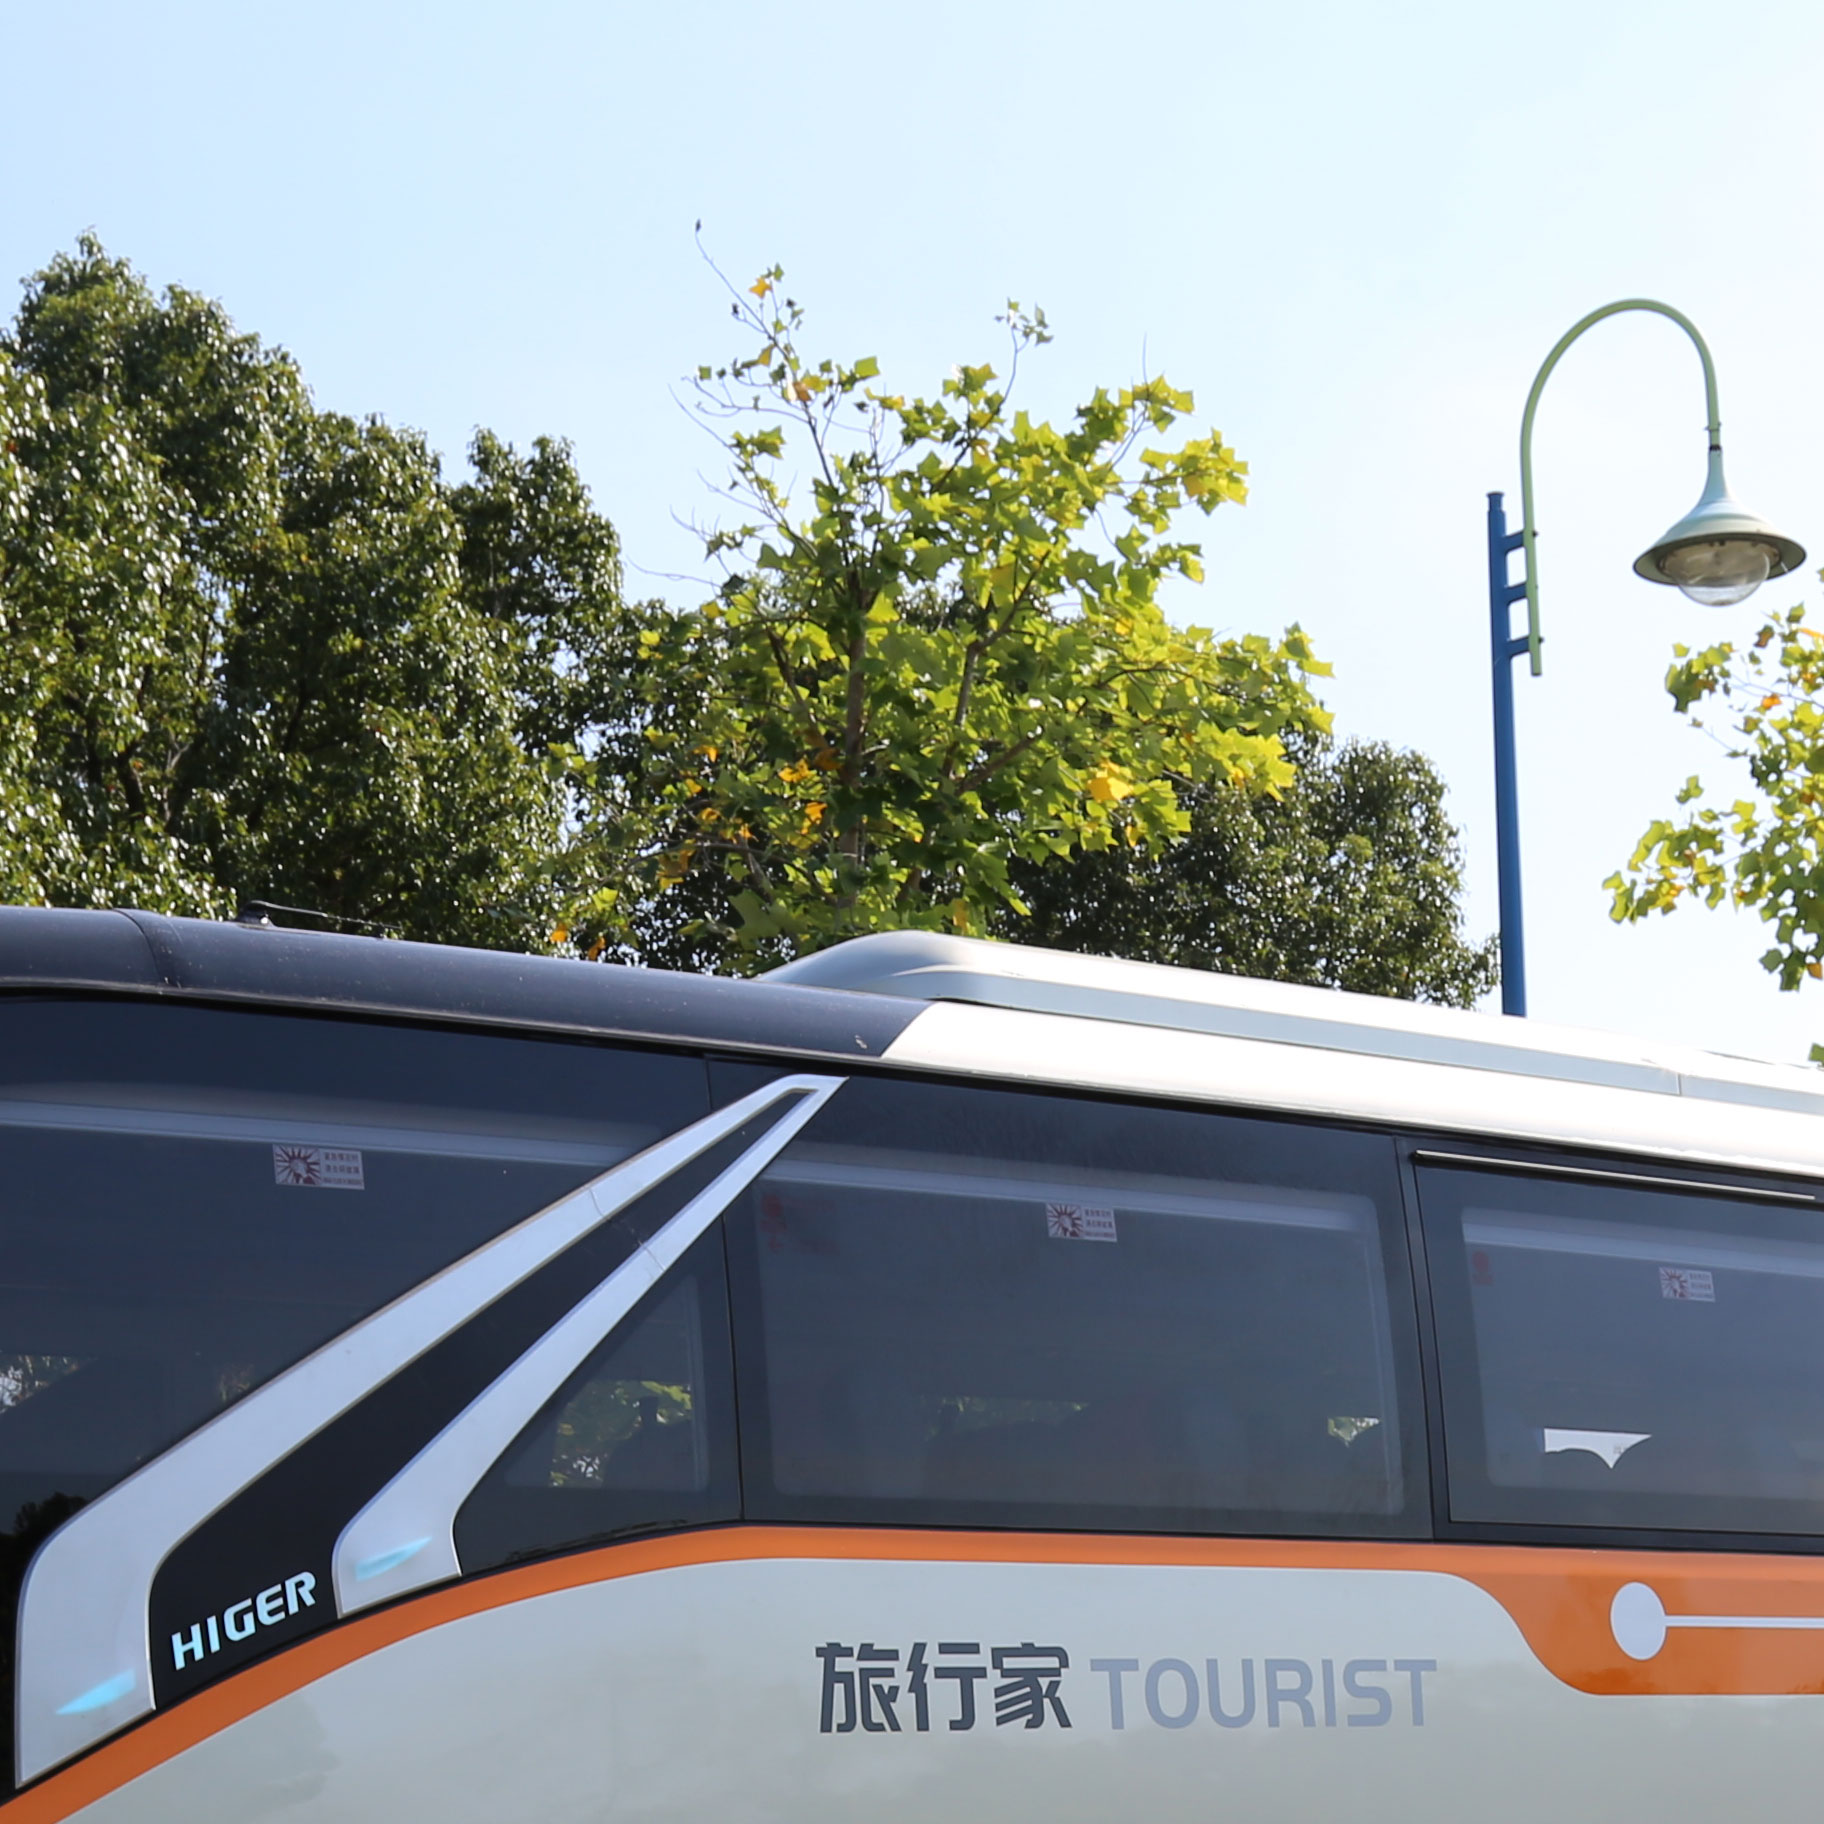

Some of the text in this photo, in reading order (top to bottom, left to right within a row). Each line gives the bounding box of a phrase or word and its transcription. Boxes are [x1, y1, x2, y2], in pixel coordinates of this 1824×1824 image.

[171, 1571, 316, 1671] HIGER
[815, 1642, 1438, 1733] 旅行家 TOURIST
